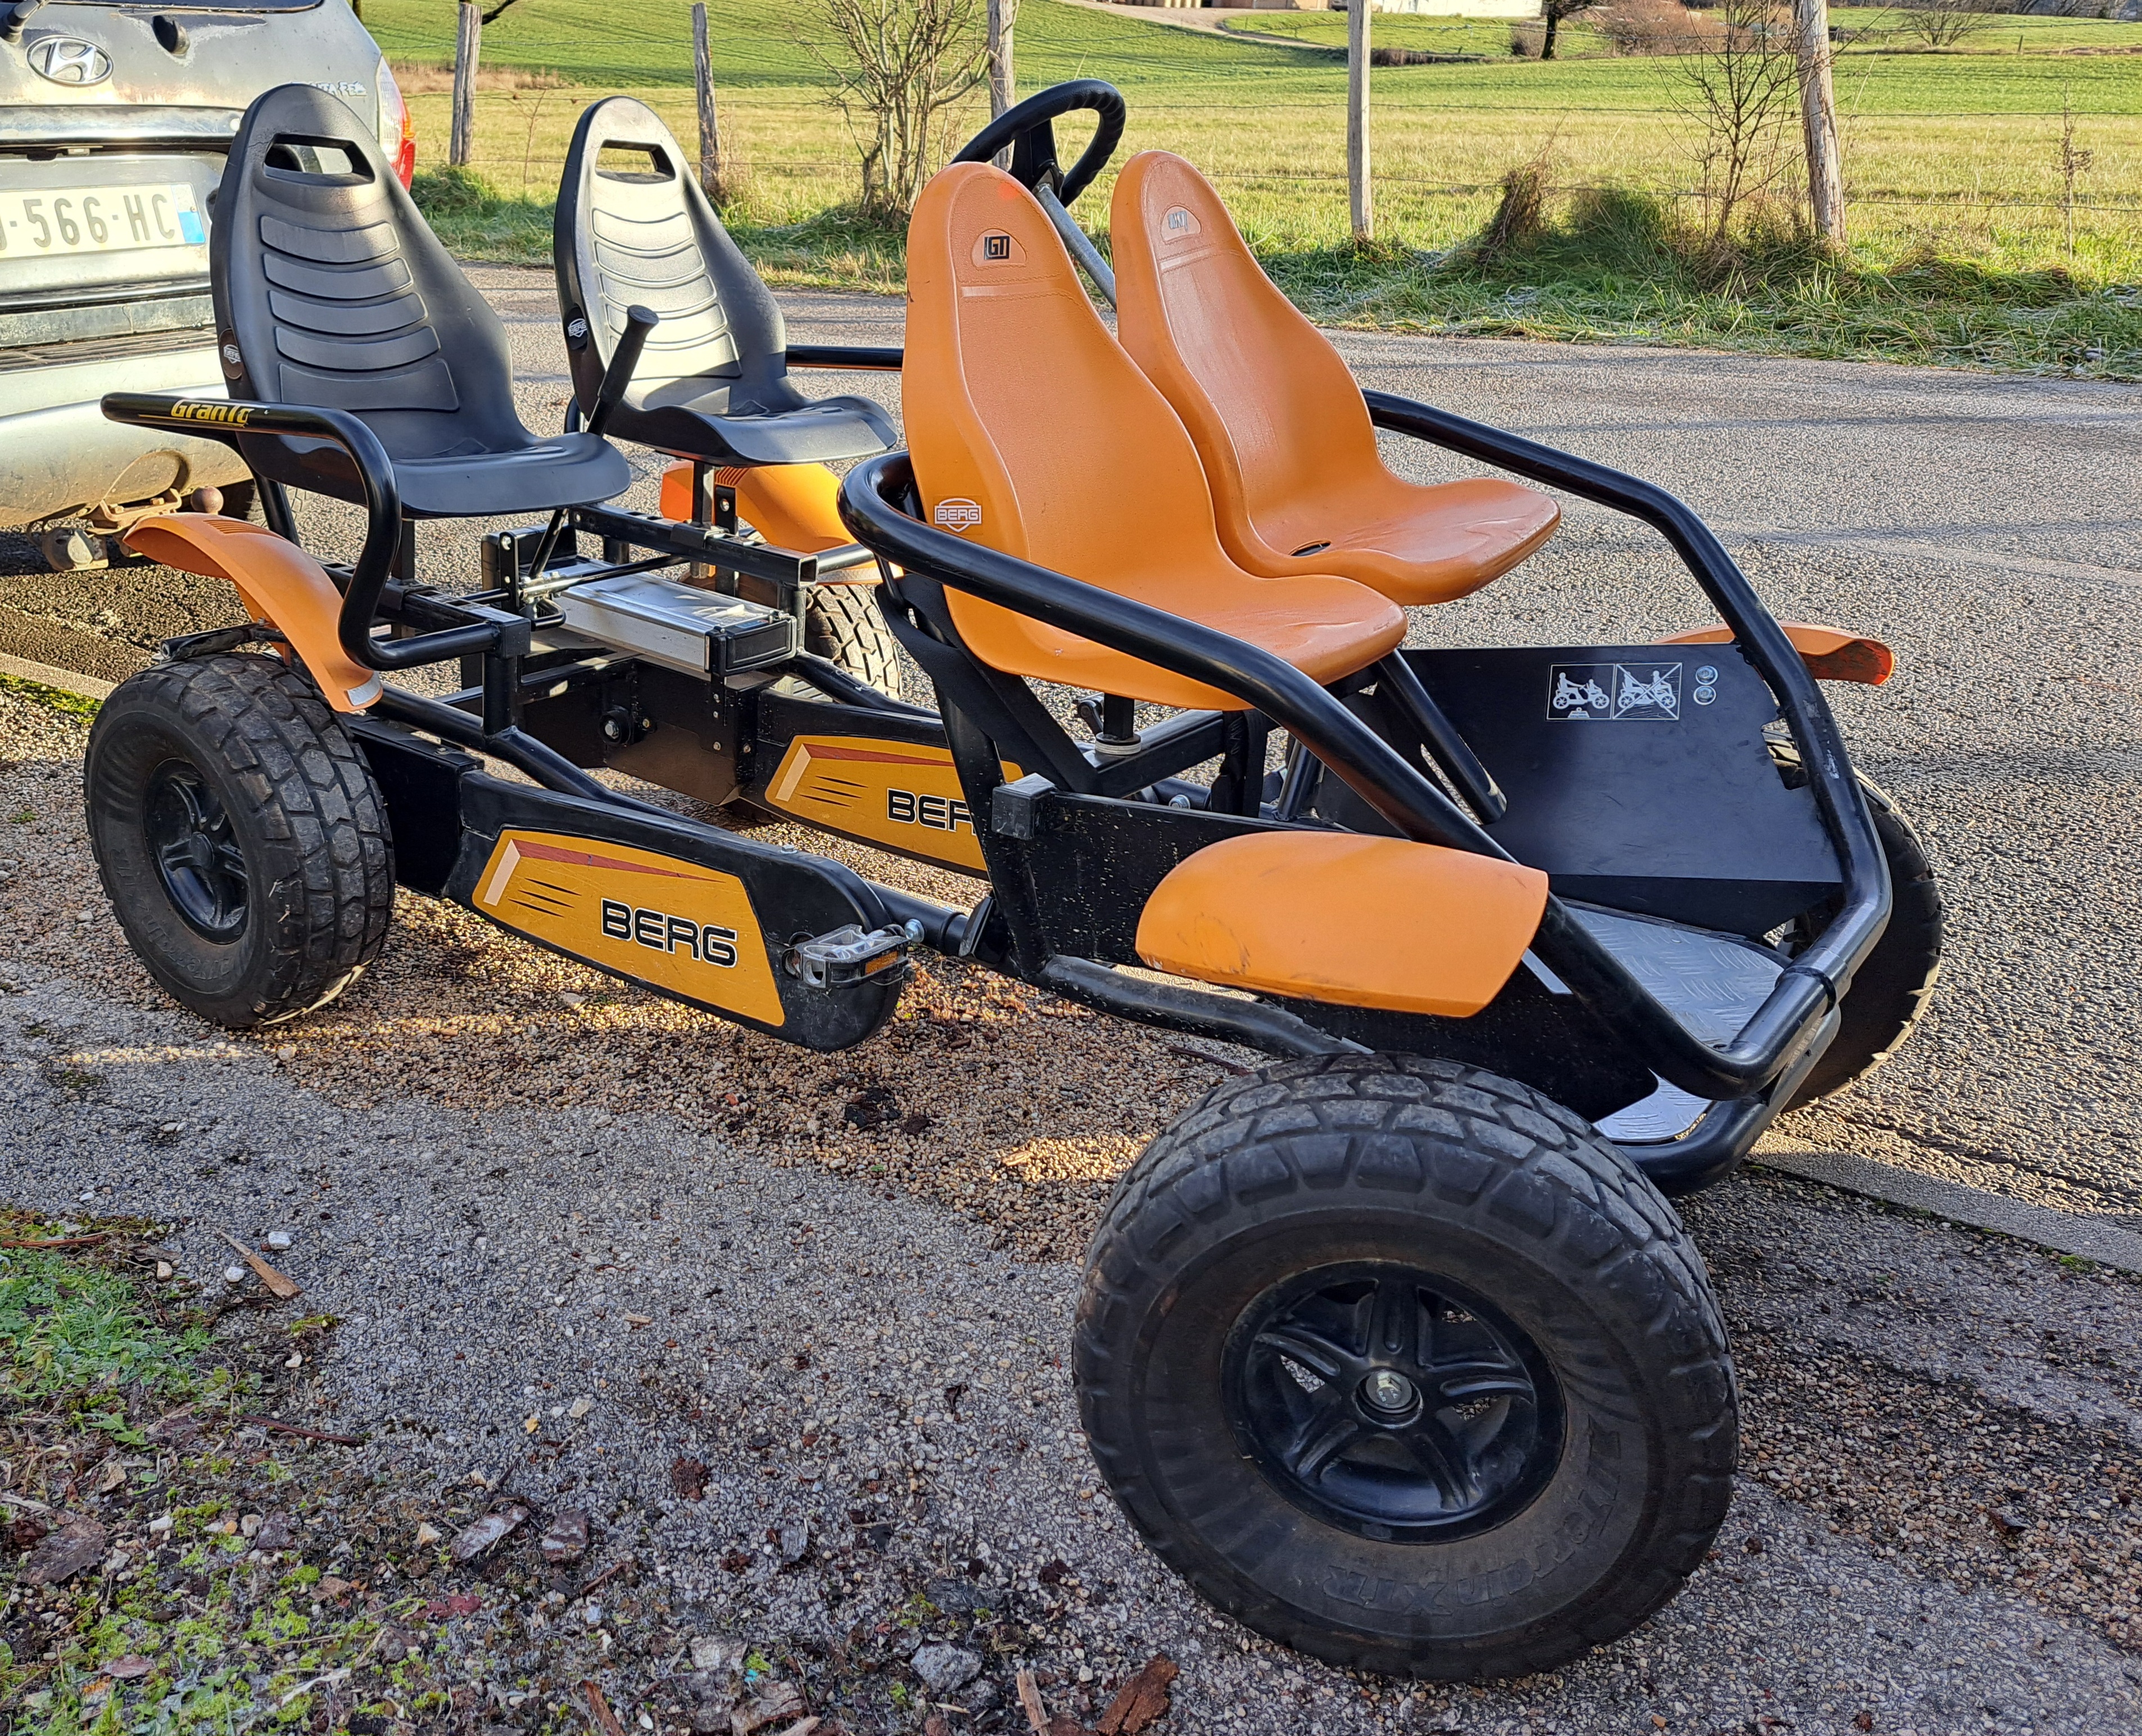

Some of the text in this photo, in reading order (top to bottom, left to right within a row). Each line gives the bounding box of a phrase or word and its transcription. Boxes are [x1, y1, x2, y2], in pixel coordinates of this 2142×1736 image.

[937, 509, 979, 520] BERG
[887, 788, 976, 836] BER
[601, 898, 737, 968] BERG
